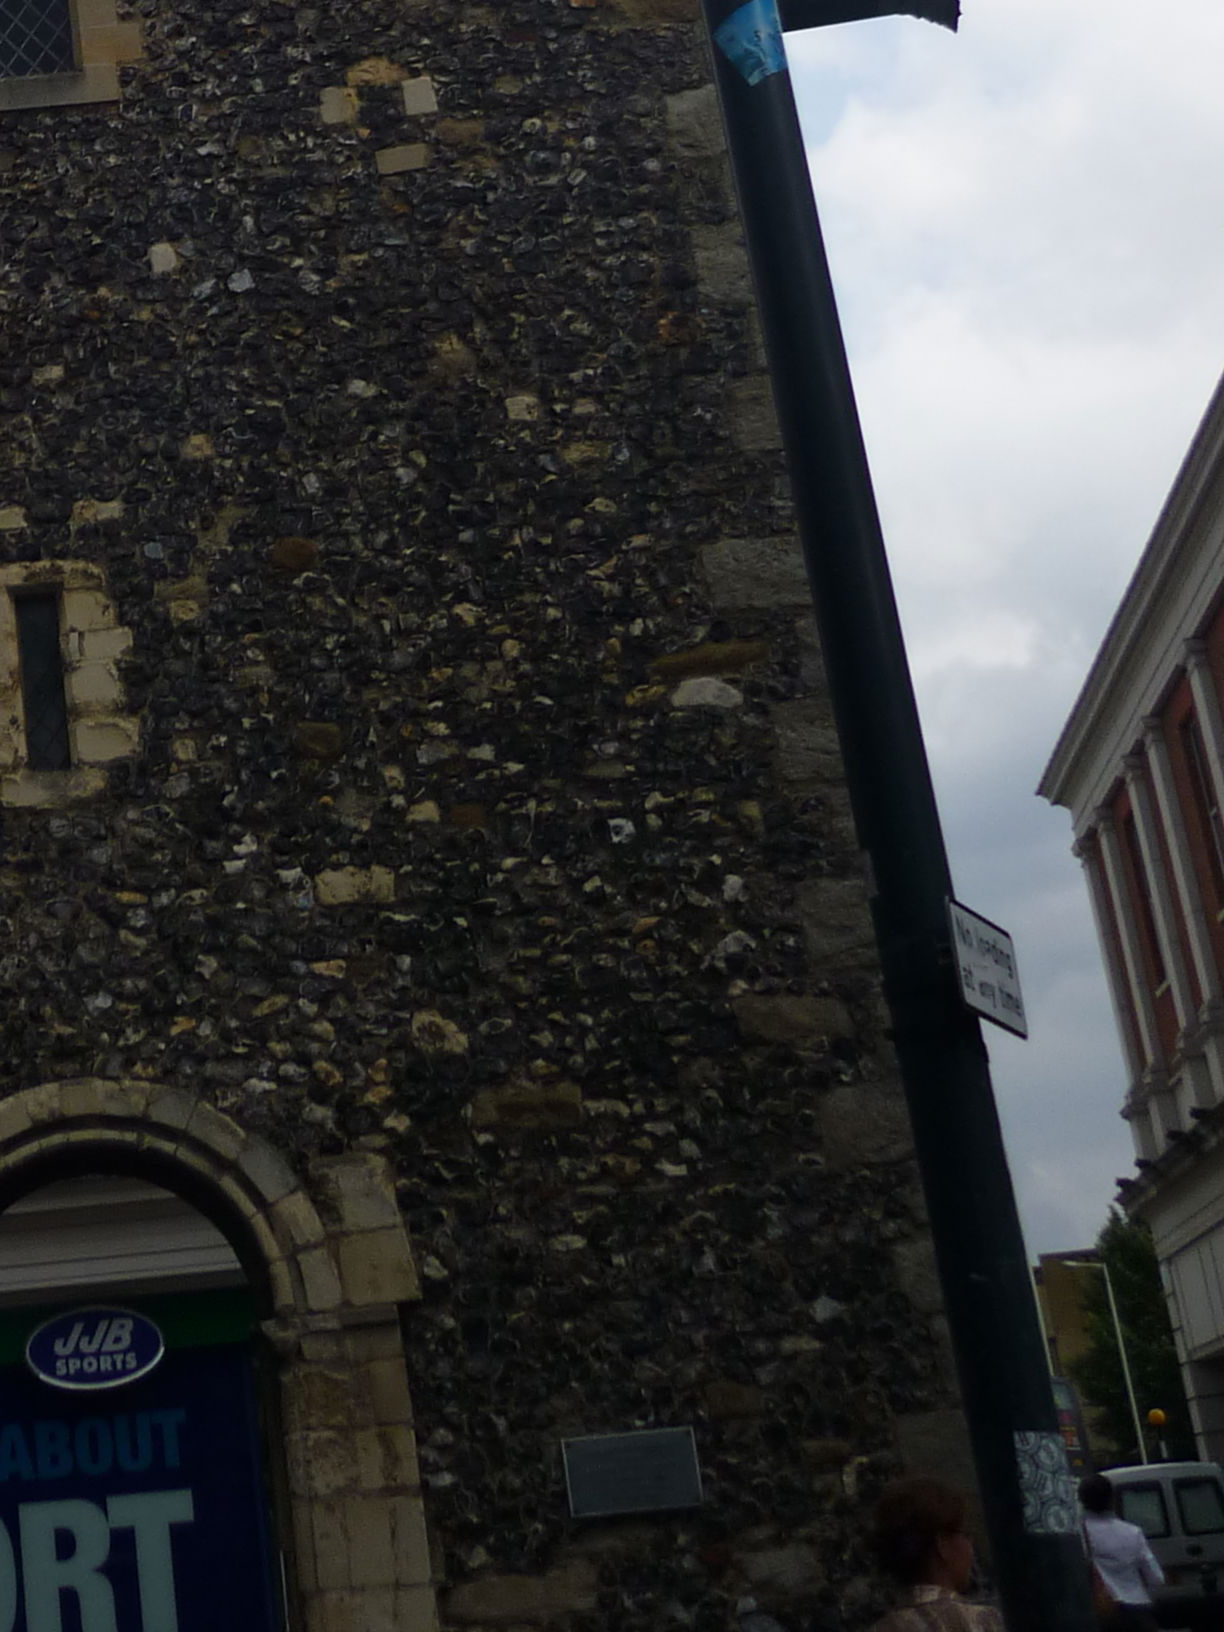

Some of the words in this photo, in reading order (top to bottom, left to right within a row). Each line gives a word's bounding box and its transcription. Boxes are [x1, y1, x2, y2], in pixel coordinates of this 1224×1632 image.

[975, 927, 1014, 980] loading
[998, 981, 1024, 1018] time
[53, 1316, 136, 1356] JJB
[54, 1351, 137, 1377] SPORTS
